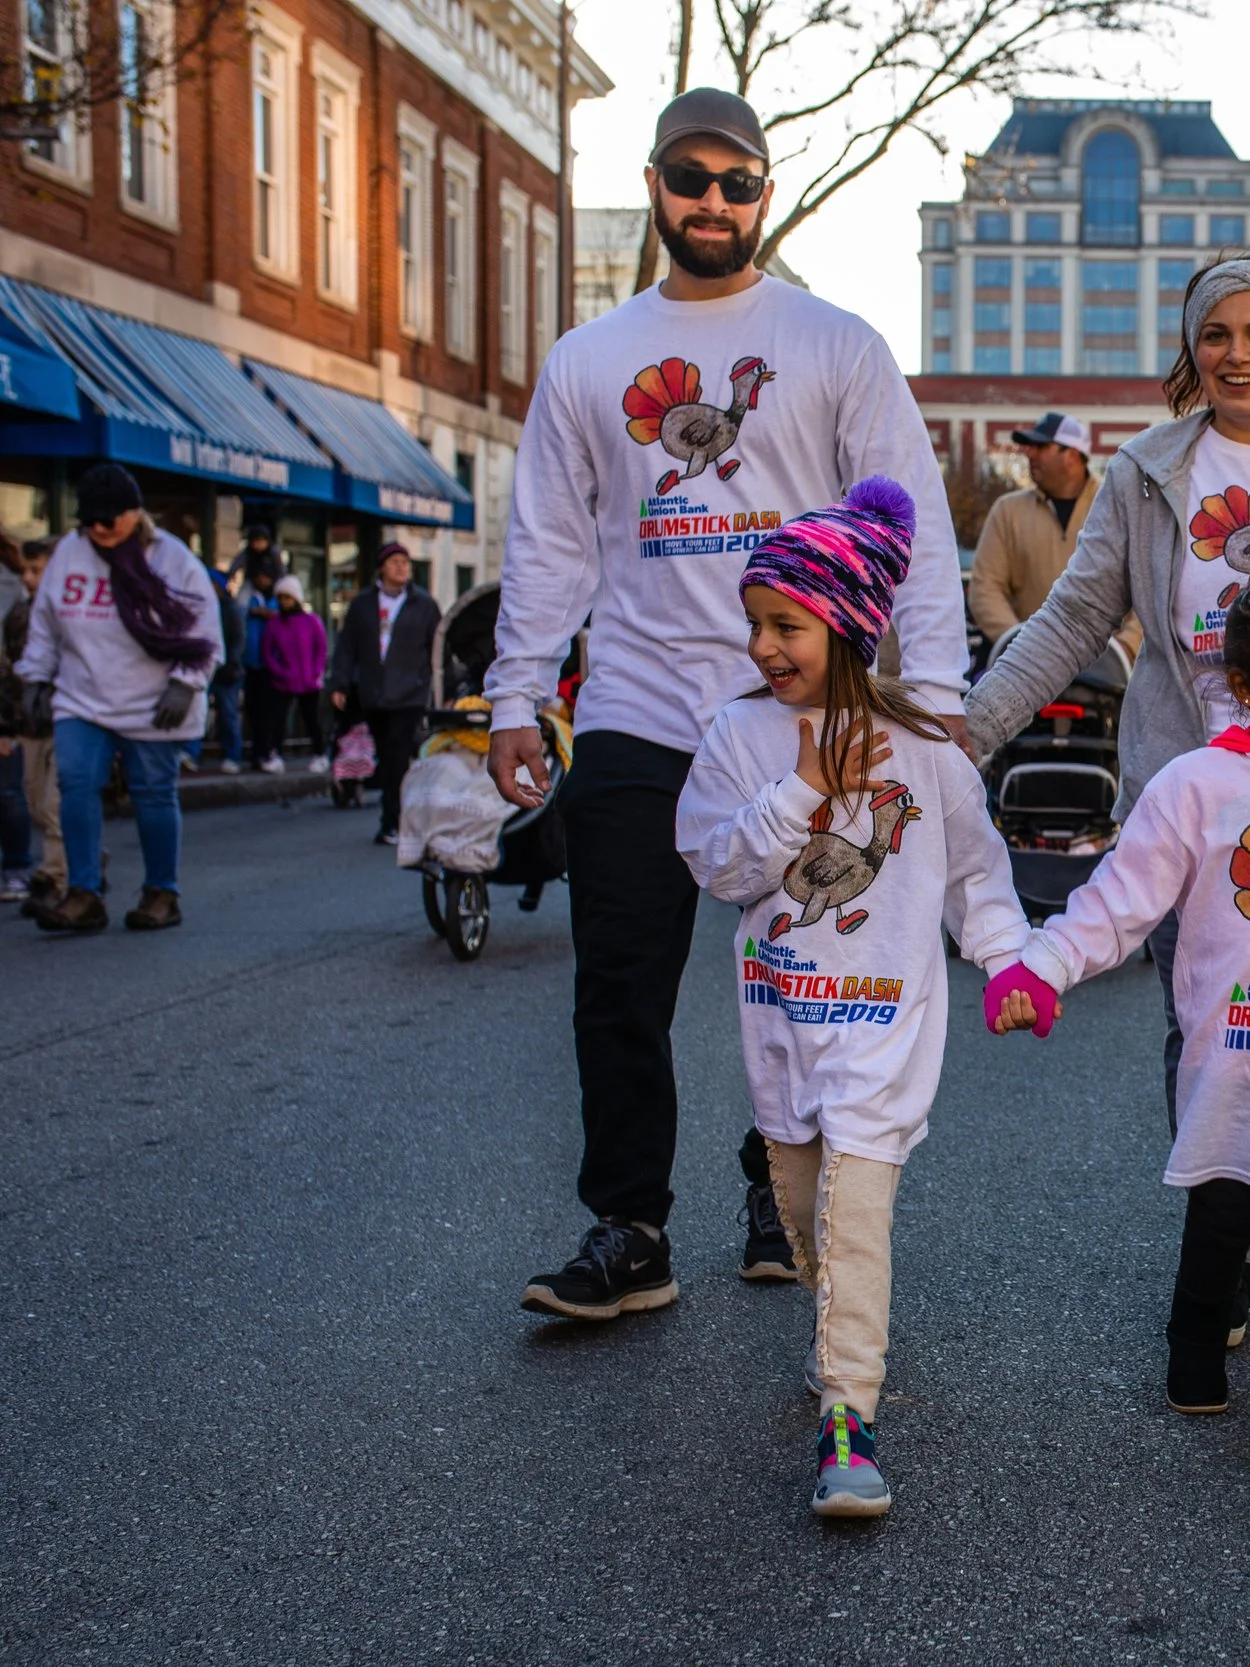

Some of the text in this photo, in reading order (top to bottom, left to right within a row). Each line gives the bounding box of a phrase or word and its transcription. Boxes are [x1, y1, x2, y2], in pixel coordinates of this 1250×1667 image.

[648, 495, 689, 506] Atlantic
[648, 503, 709, 516] Union Bank
[640, 511, 781, 539] DRUMSTICK DASH
[1205, 610, 1228, 620] Atla
[1206, 619, 1226, 629] Uni
[758, 938, 796, 958] Atlantic
[758, 949, 818, 972] Union Bank
[840, 976, 903, 1003] DASH
[805, 1005, 825, 1014] FEET
[828, 1003, 898, 1025] 2019
[792, 1012, 807, 1021] CAN
